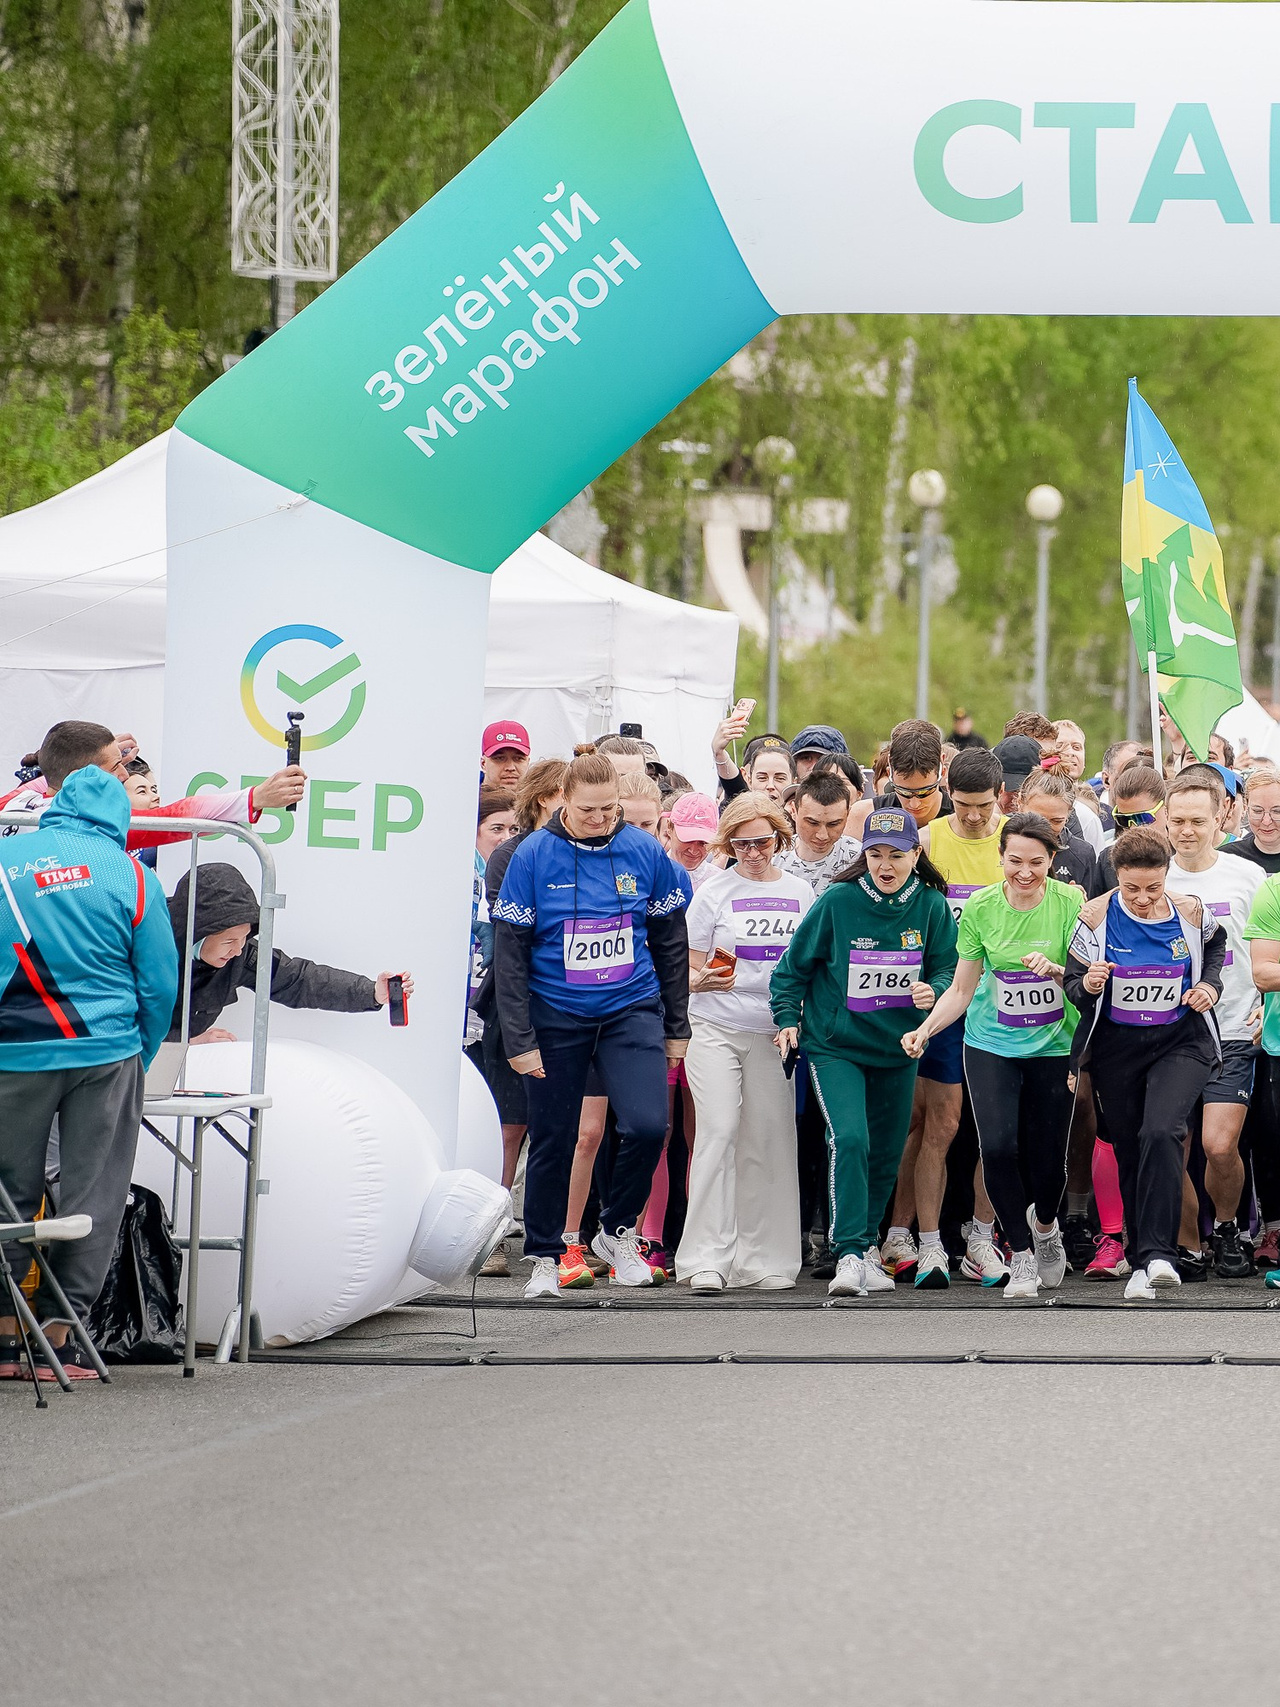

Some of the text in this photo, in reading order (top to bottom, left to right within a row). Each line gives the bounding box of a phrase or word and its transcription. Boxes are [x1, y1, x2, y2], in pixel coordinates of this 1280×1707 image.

[364, 181, 600, 411] зелёный
[403, 238, 642, 458] марафон
[8, 856, 61, 881] RACE
[41, 868, 82, 885] TIME
[746, 919, 795, 936] 2244
[576, 937, 625, 960] 2000
[859, 973, 911, 989] 2186
[1003, 988, 1055, 1007] 2100
[1122, 986, 1175, 1002] 2074
